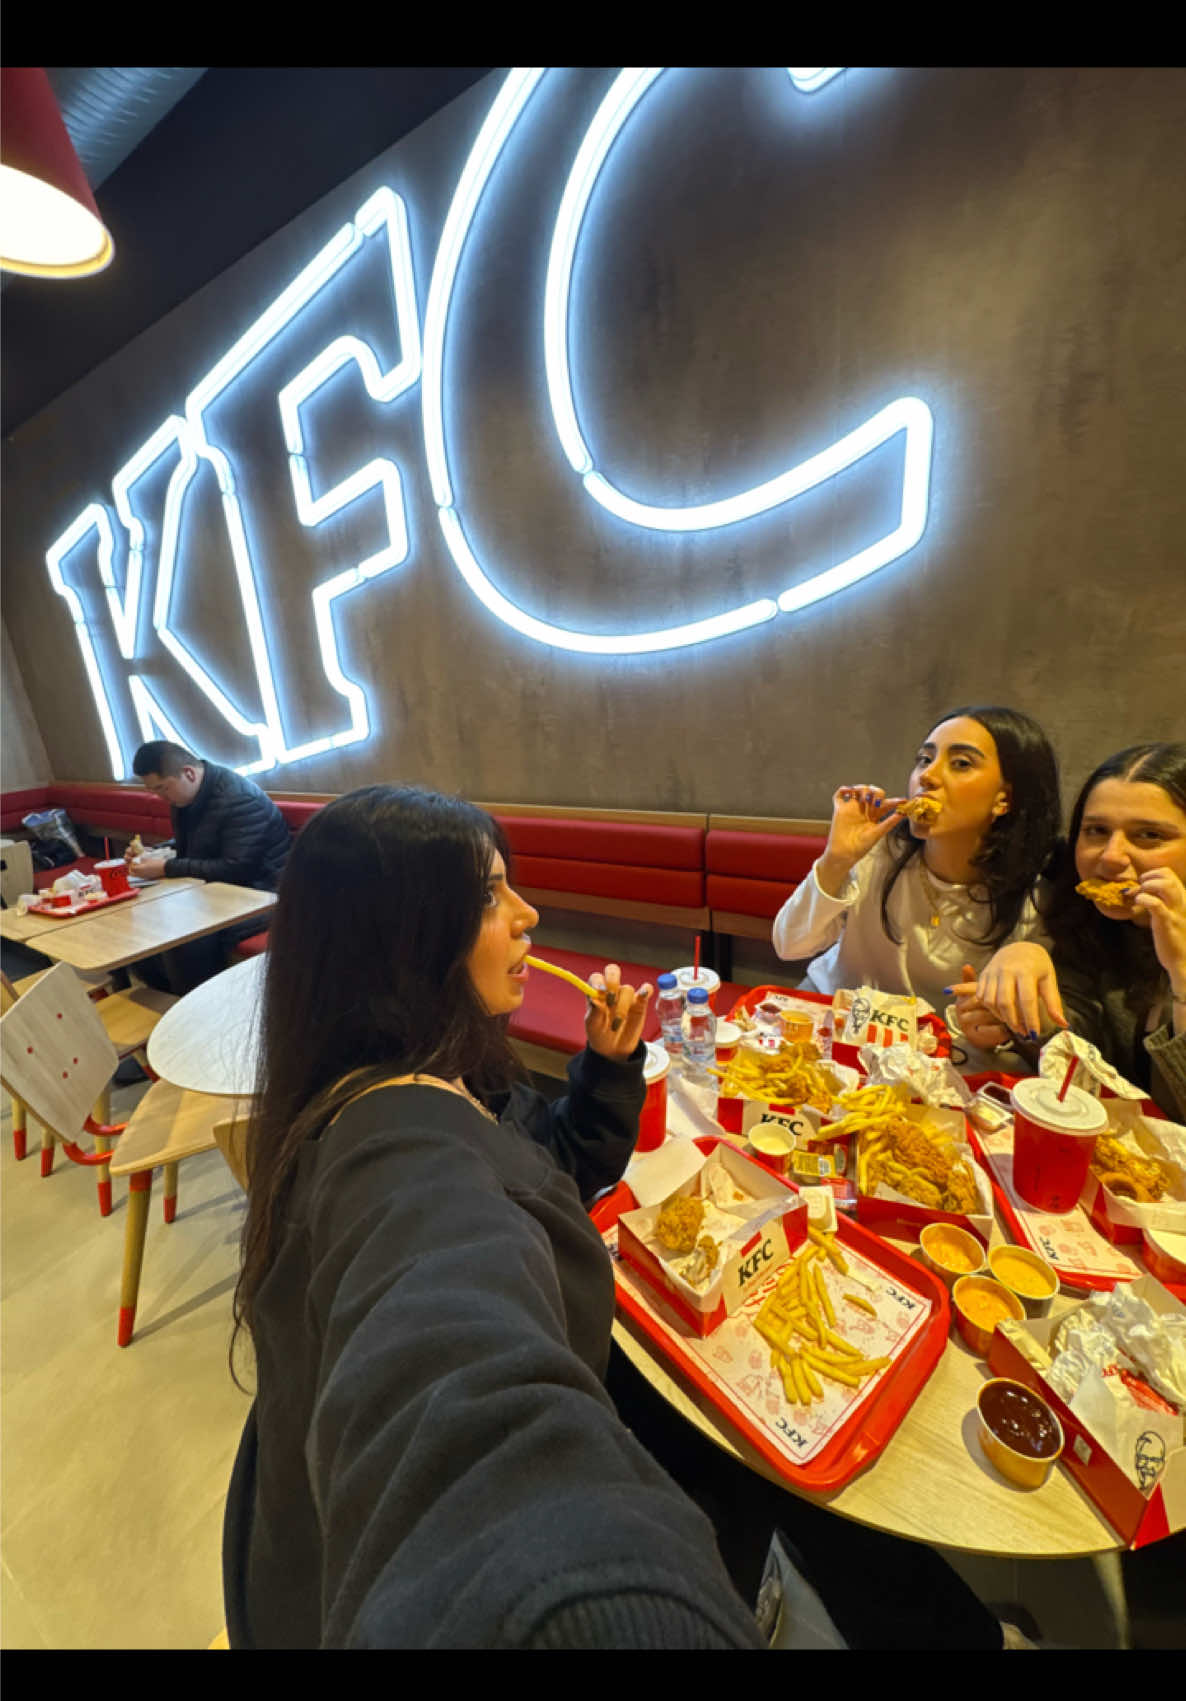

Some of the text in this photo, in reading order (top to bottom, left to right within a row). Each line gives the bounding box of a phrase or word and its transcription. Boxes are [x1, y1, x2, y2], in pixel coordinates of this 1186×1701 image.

[45, 68, 934, 780] KFC
[869, 1010, 909, 1032] KFC
[738, 1239, 774, 1288] KFC
[886, 1286, 916, 1310] KFC
[775, 1416, 808, 1448] KFC
